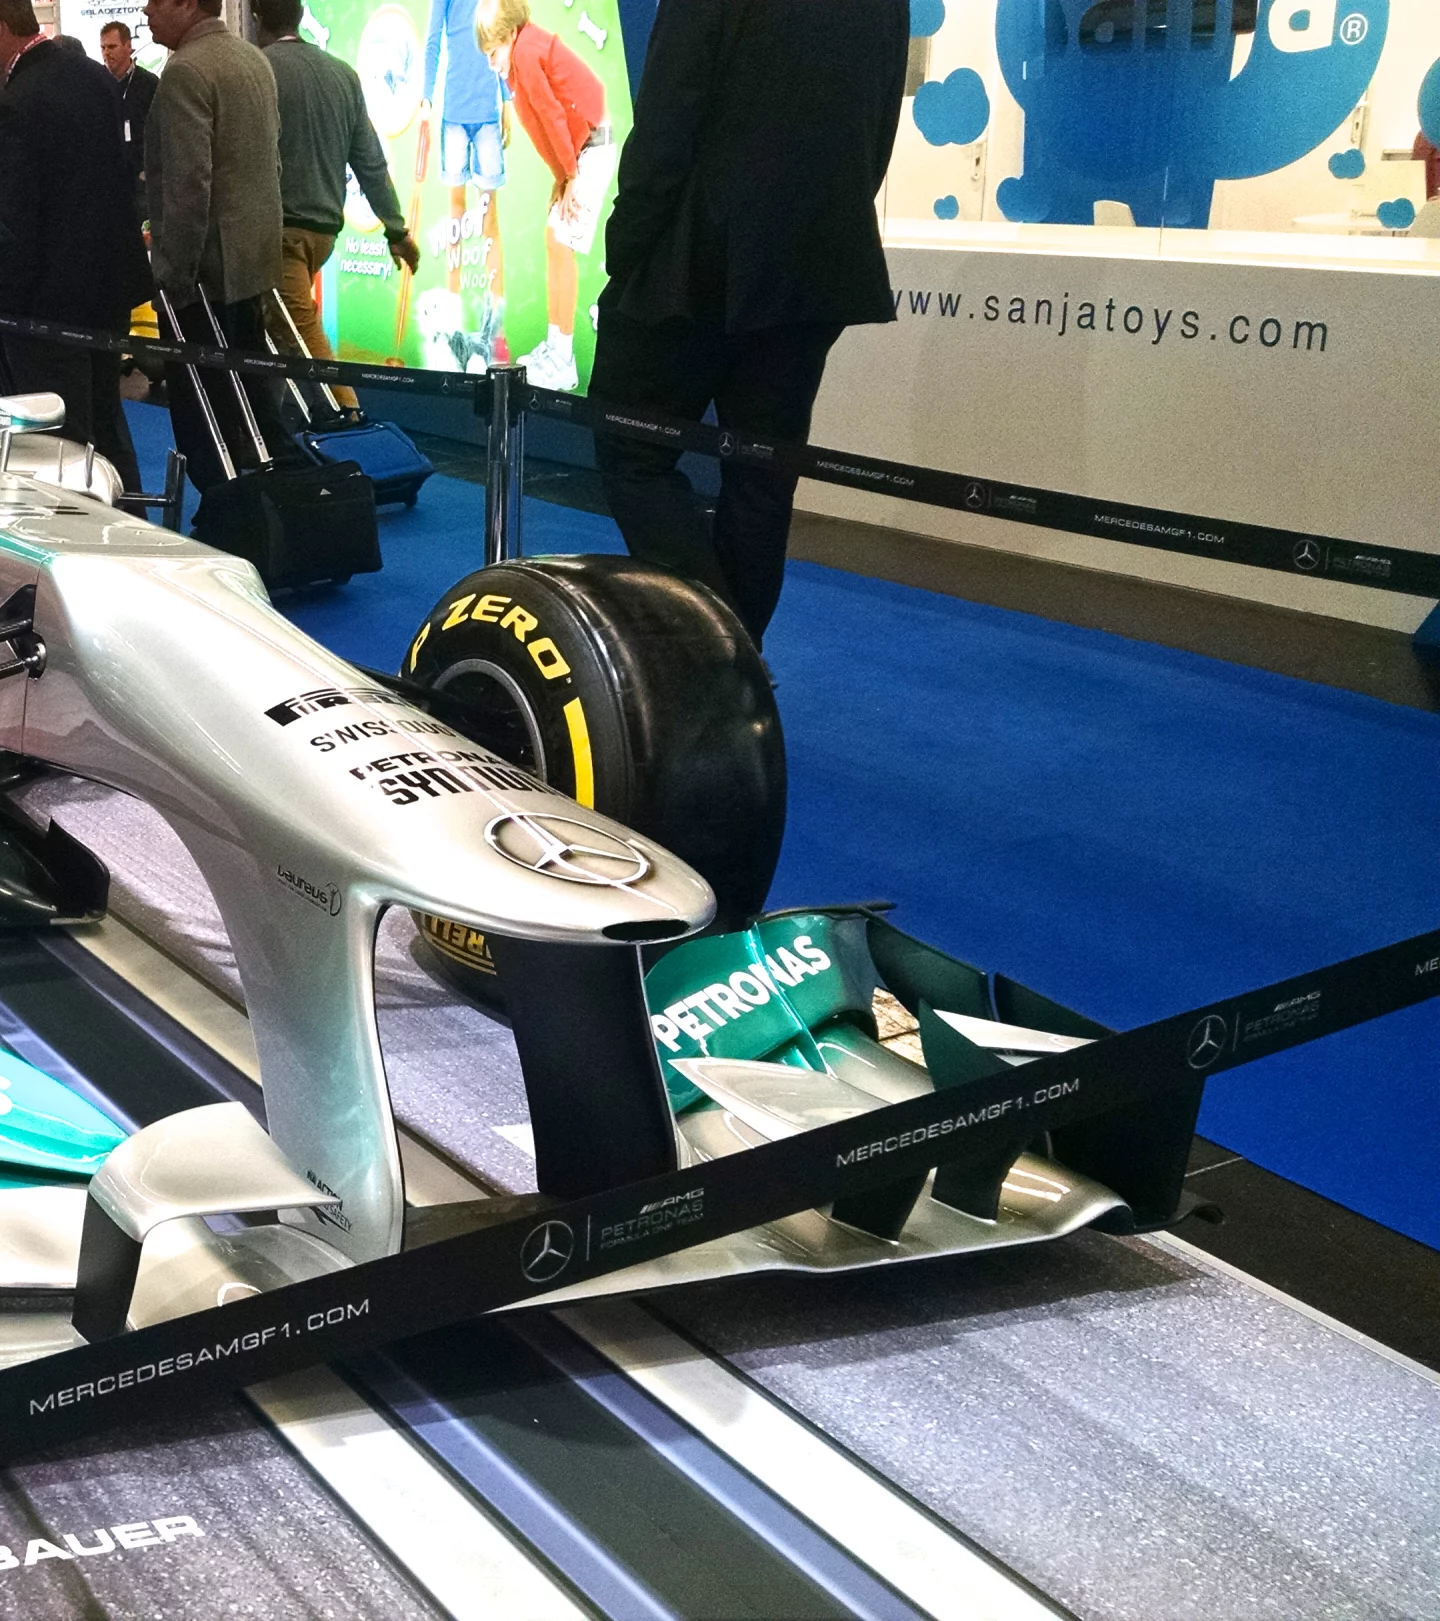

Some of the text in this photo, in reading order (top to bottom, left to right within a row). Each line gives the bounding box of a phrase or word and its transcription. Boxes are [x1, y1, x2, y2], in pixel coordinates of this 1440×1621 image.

[1094, 513, 1225, 545] MERCEDESAMGF1.COM
[442, 592, 572, 681] ZERO
[349, 750, 506, 781] PETRONA
[649, 935, 832, 1053] PETRONAS
[835, 1077, 1081, 1169] MERCEDESAMGF1.COM
[600, 1200, 704, 1241] PETRONAS
[29, 1298, 370, 1416] MERCEDESAMGF1.COM
